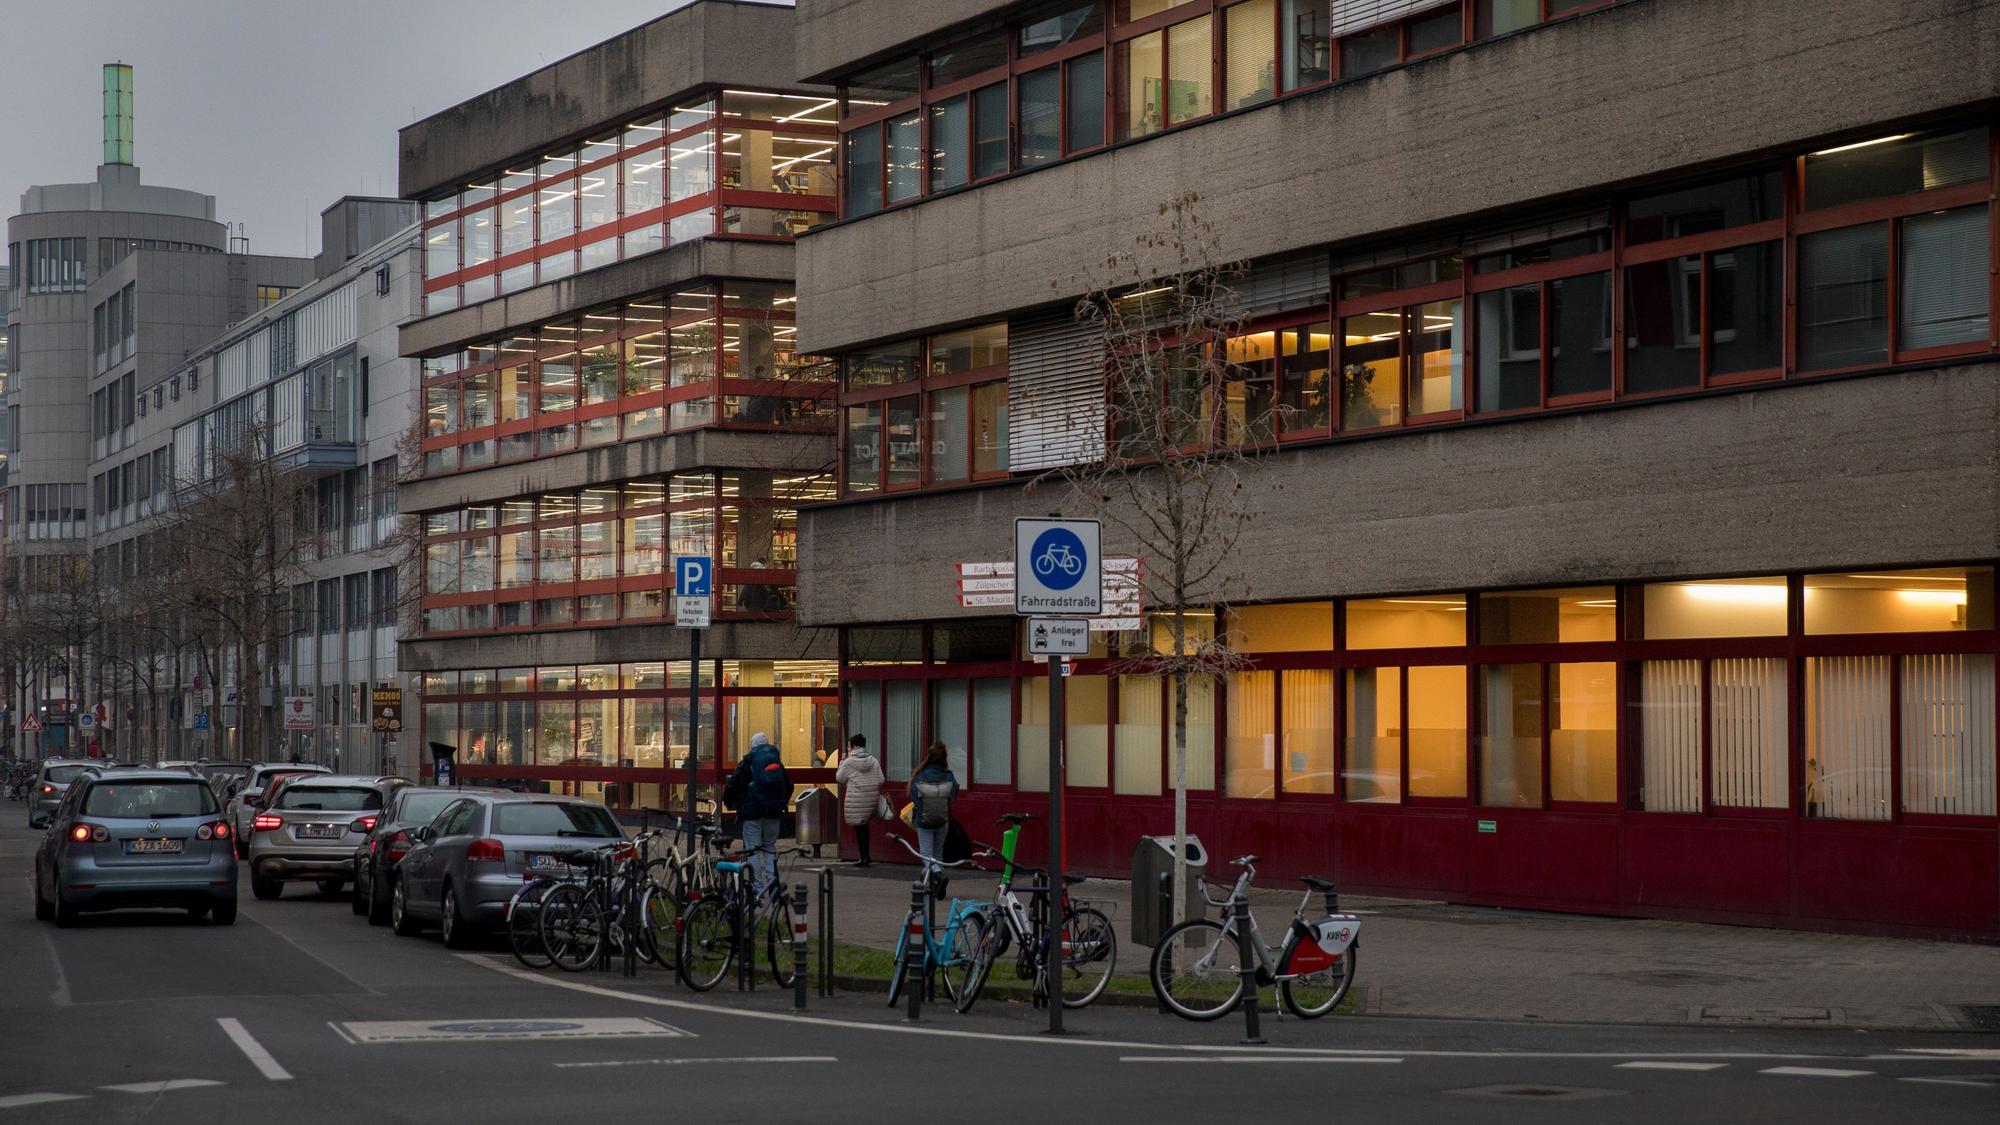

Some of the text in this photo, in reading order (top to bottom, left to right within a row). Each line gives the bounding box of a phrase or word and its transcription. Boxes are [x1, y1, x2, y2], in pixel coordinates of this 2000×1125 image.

[974, 565, 1014, 573] Barbarossa
[684, 562, 703, 595] P
[1021, 596, 1097, 607] Fahrradstraße
[1051, 626, 1085, 637] Anlieger
[1061, 638, 1076, 647] frei
[1327, 931, 1341, 940] KVB
